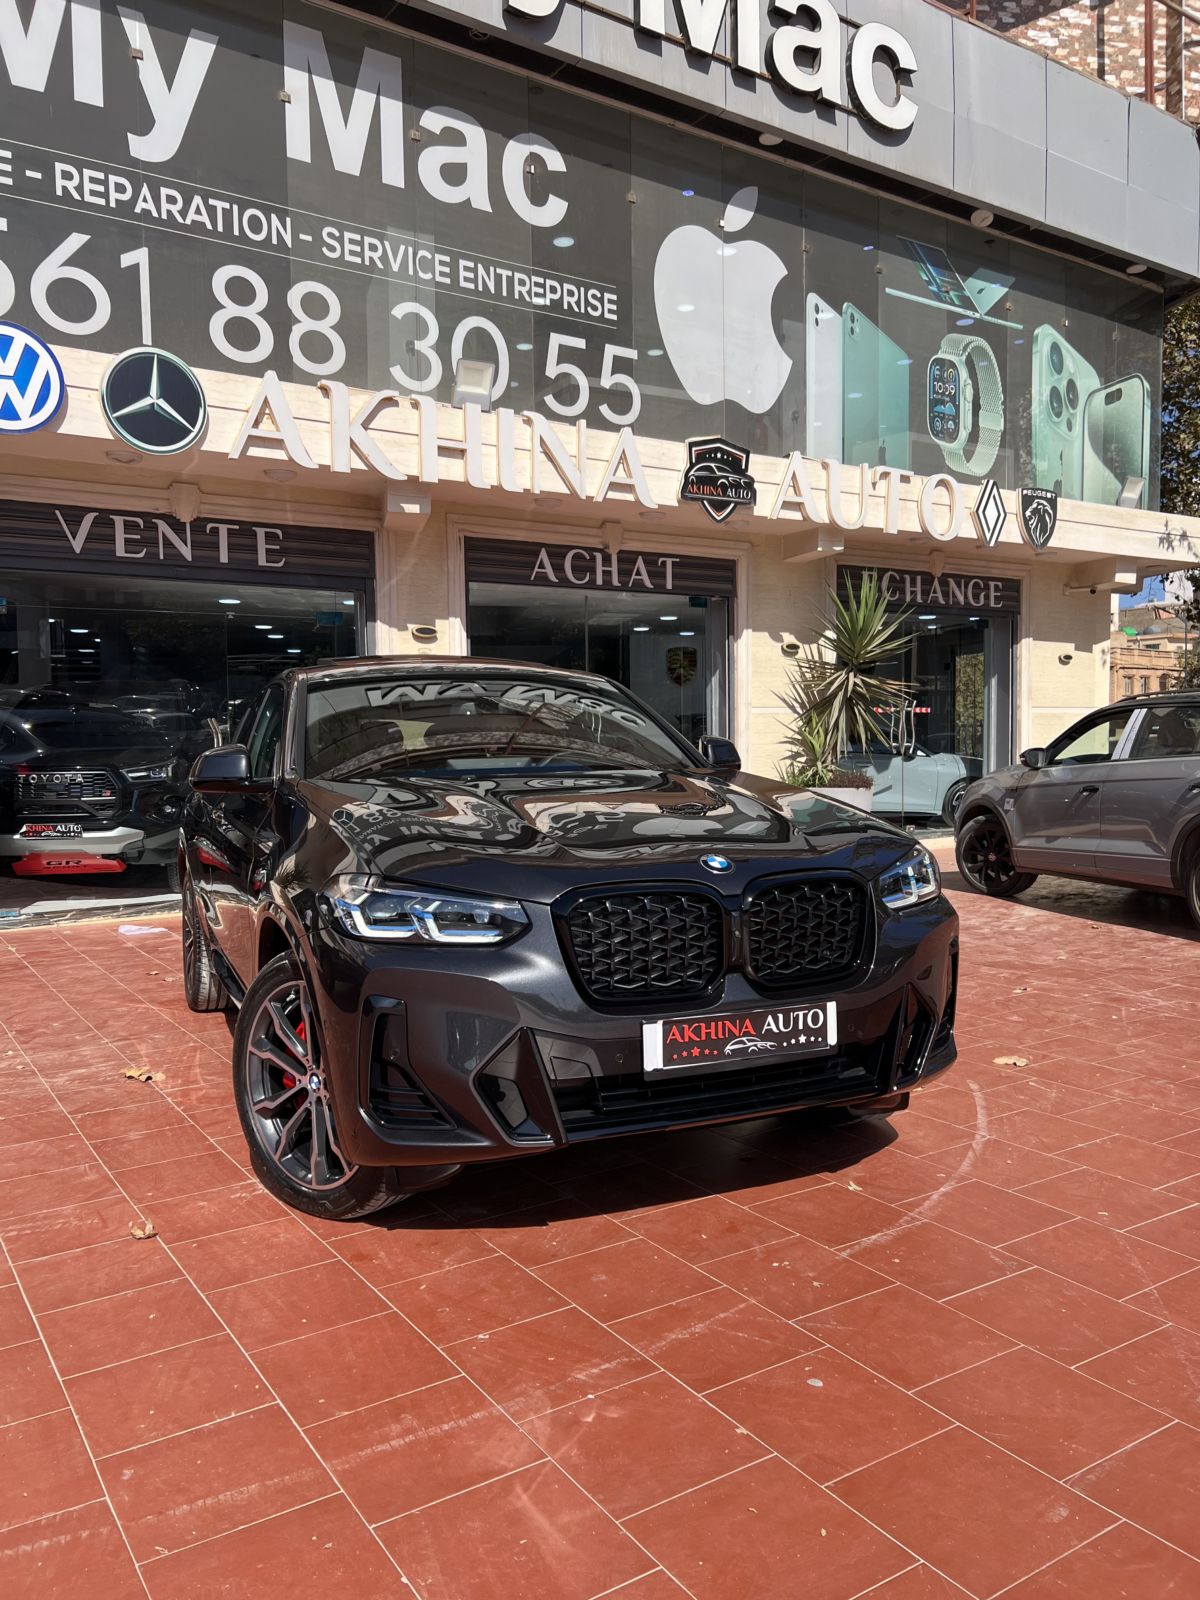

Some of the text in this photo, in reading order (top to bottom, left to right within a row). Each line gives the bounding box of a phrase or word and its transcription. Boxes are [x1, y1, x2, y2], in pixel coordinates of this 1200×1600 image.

[283, 20, 569, 228] Mac
[54, 161, 292, 248] REPARATION
[321, 226, 451, 284] SERVICE
[458, 258, 618, 321] ENTREPRISE
[209, 264, 346, 376] 88
[389, 301, 509, 403] 30
[543, 332, 642, 426] 55
[228, 370, 965, 541] AKHINA AUTO
[687, 484, 751, 499] AKHINA AUTO
[54, 509, 286, 568] VENTE
[530, 547, 681, 590] ACHAT
[18, 774, 84, 783] TOYOTA
[22, 824, 82, 832] KHINA AUTO
[666, 1008, 825, 1044] AKHINA AUTO
